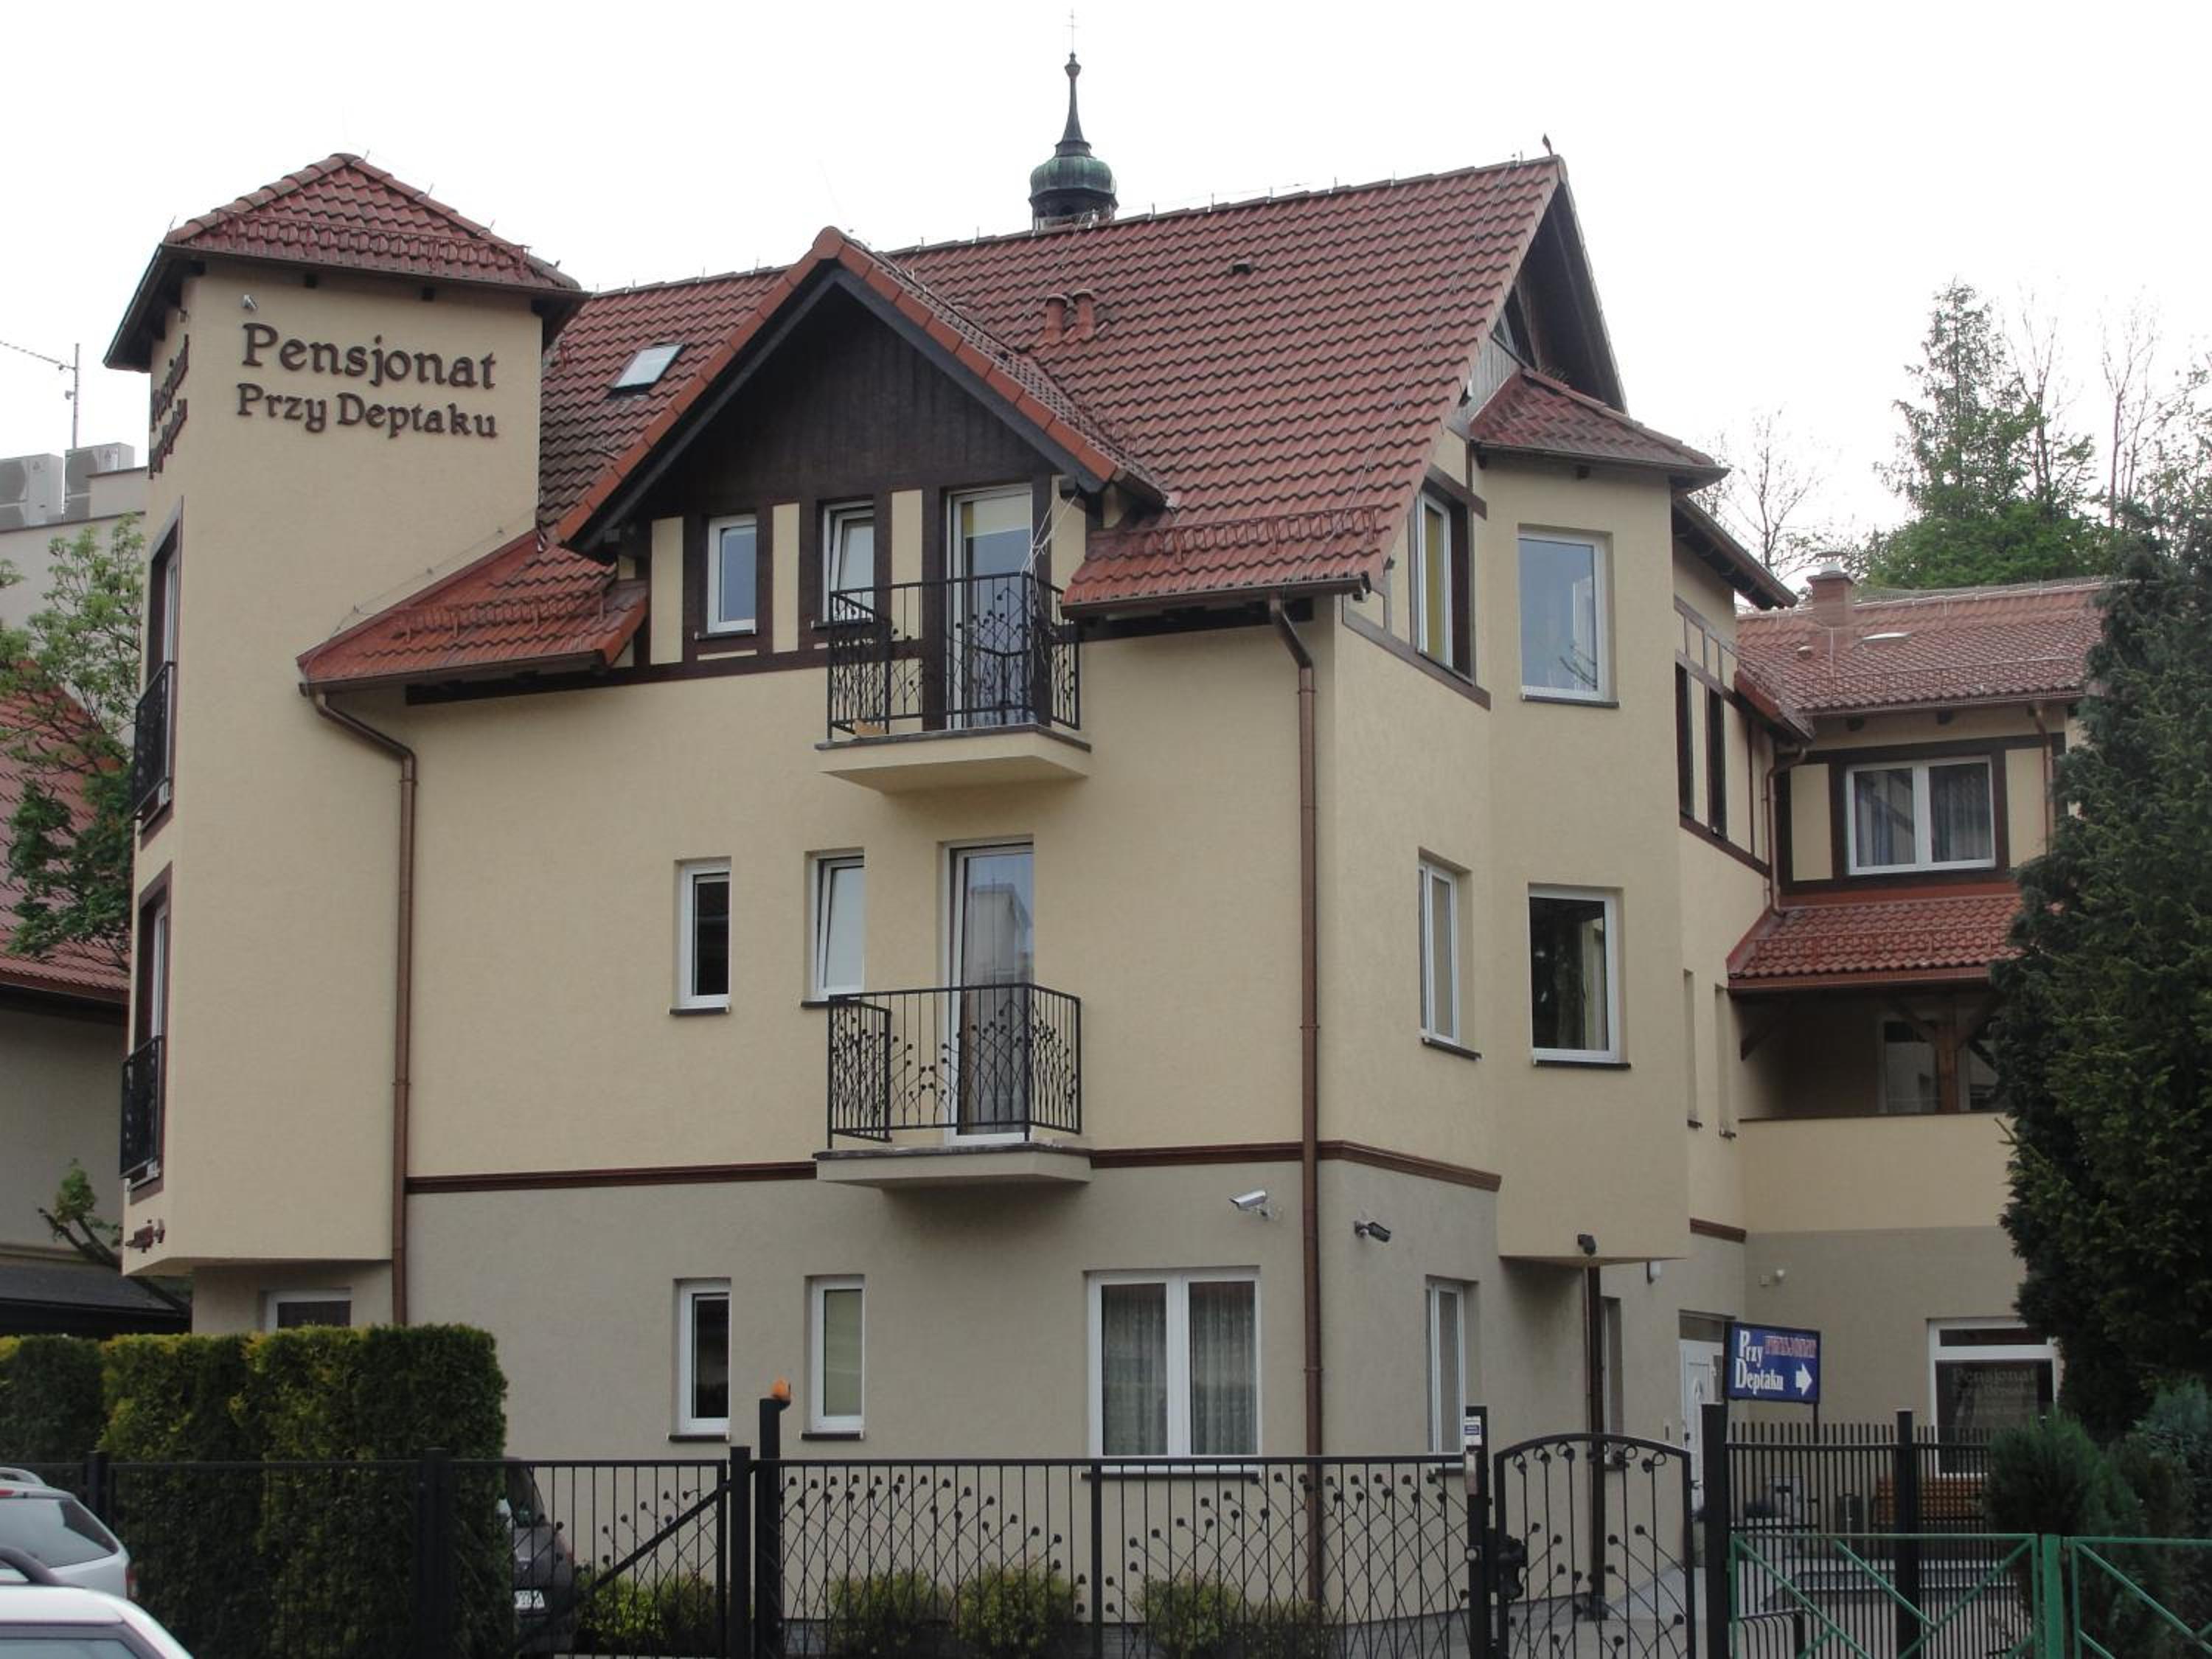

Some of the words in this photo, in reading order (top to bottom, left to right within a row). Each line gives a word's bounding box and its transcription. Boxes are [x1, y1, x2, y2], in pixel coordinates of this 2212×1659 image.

[242, 322, 496, 390] Pensjonat
[237, 383, 327, 434] Przy
[336, 392, 498, 439] Deptaku
[1739, 1329, 1764, 1368] Przy
[1734, 1357, 1784, 1396] Deptaku
